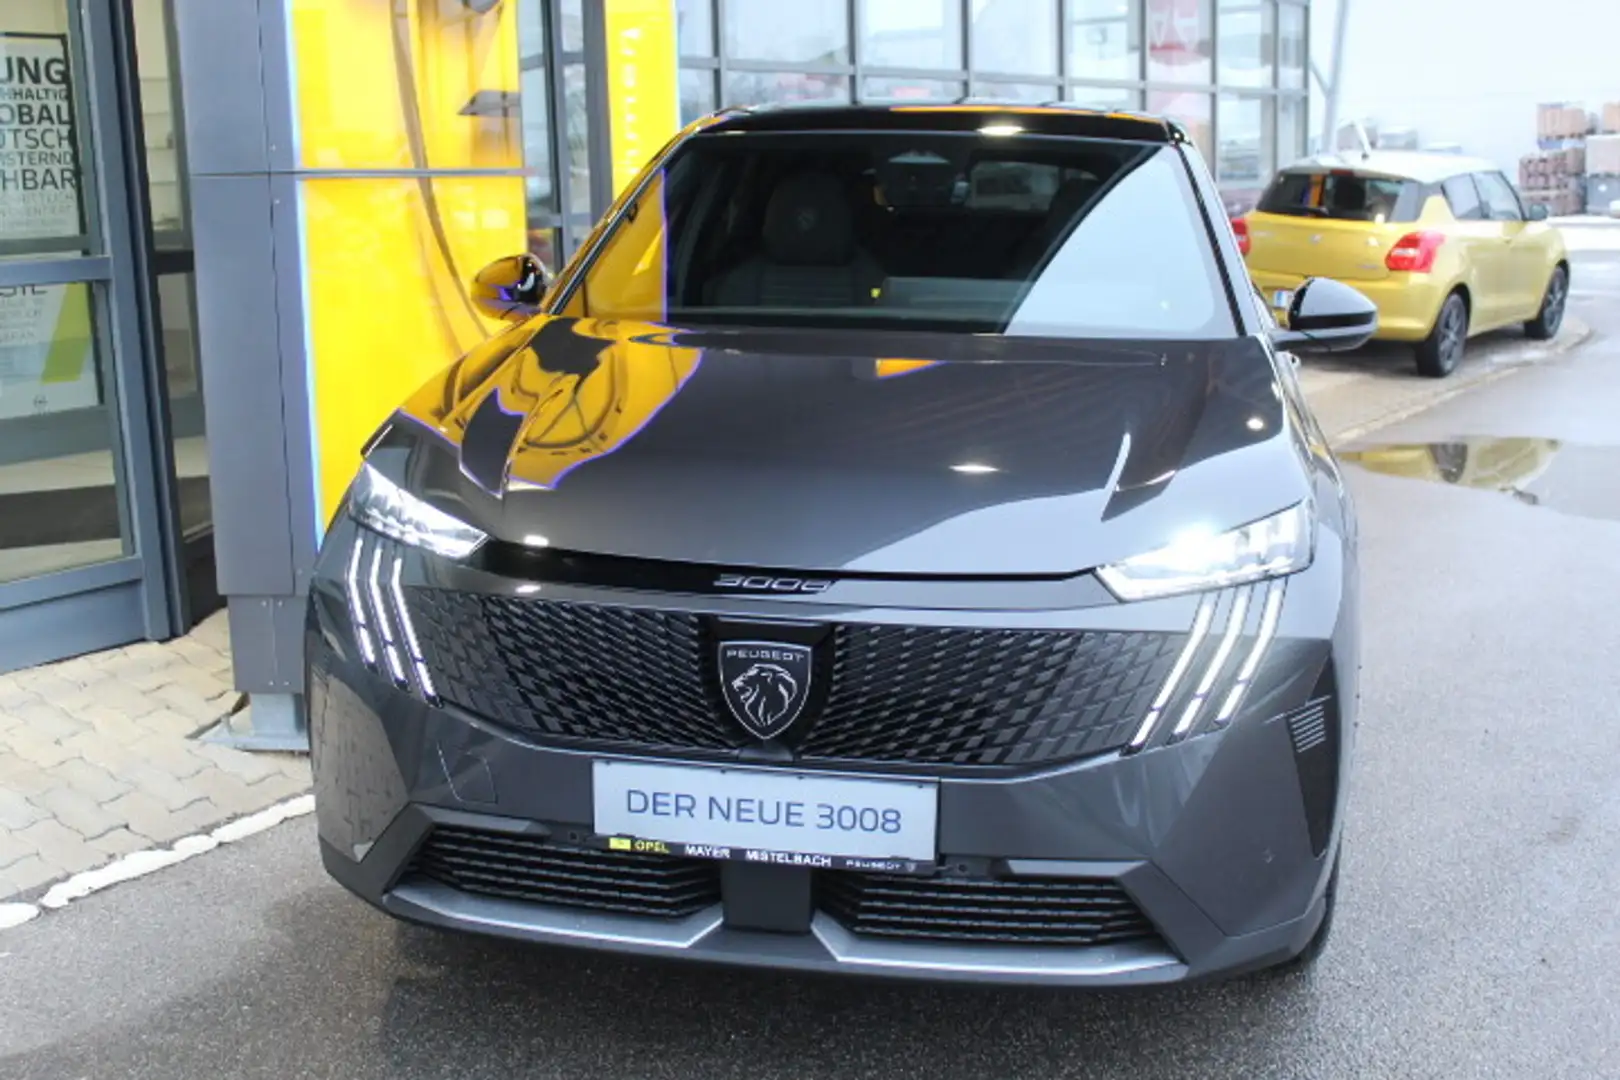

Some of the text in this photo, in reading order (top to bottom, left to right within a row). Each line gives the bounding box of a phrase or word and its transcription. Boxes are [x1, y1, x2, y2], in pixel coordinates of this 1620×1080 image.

[713, 574, 833, 591] 3008
[726, 649, 805, 662] PEUGEOT
[626, 788, 902, 833] DER NEUE 3008
[634, 840, 669, 854] OPEL
[684, 844, 731, 858] MAYER
